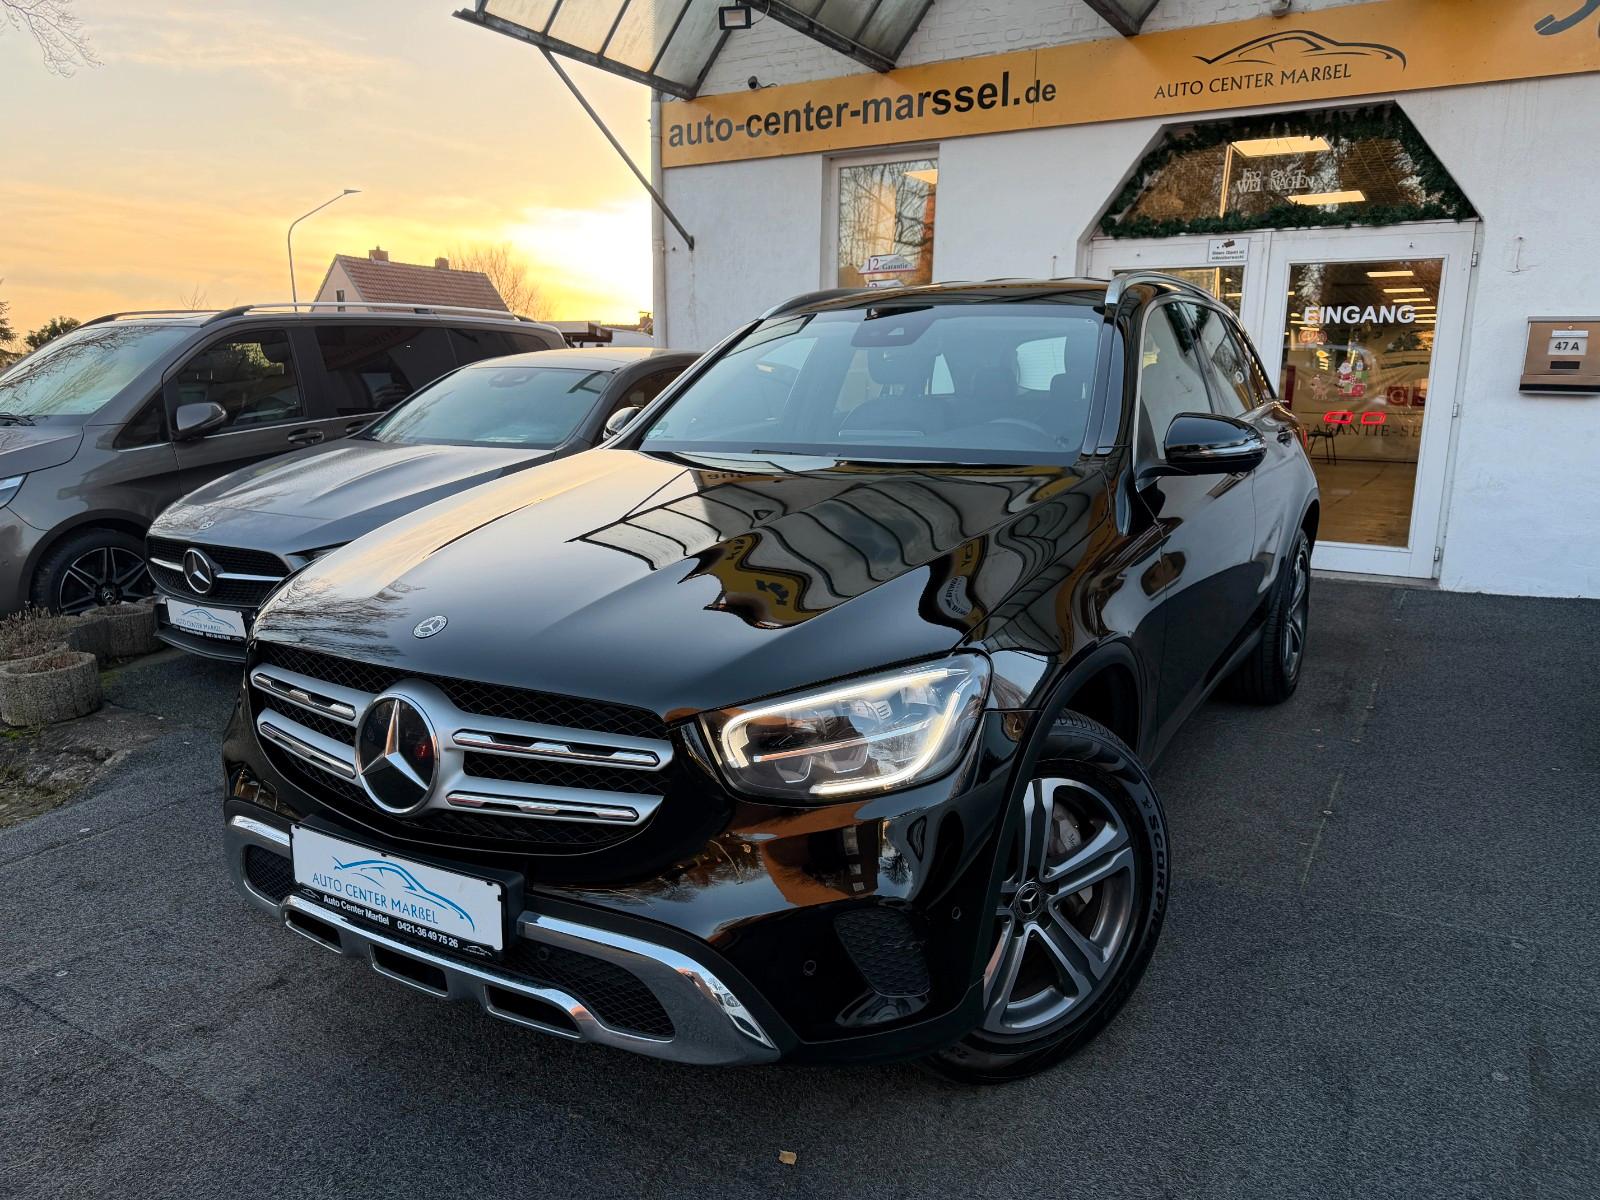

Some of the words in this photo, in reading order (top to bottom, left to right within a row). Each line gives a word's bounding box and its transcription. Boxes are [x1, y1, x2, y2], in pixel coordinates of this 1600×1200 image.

[1153, 80, 1204, 99] AUTO
[1209, 72, 1274, 92] CENTER
[669, 71, 1056, 147] auto-center-marssel.de
[867, 257, 879, 271] 12
[882, 263, 908, 271] Garantie
[1303, 305, 1415, 325] EINGANG
[1554, 341, 1569, 351] 47
[1570, 341, 1579, 351] A
[312, 872, 342, 892] AUTO
[345, 884, 388, 908] CENTER
[323, 894, 340, 908] Auto
[340, 899, 364, 916] Center
[397, 920, 427, 937] 0421-36
[427, 928, 437, 941] 49
[437, 933, 448, 945] 75
[448, 937, 459, 948] 26
